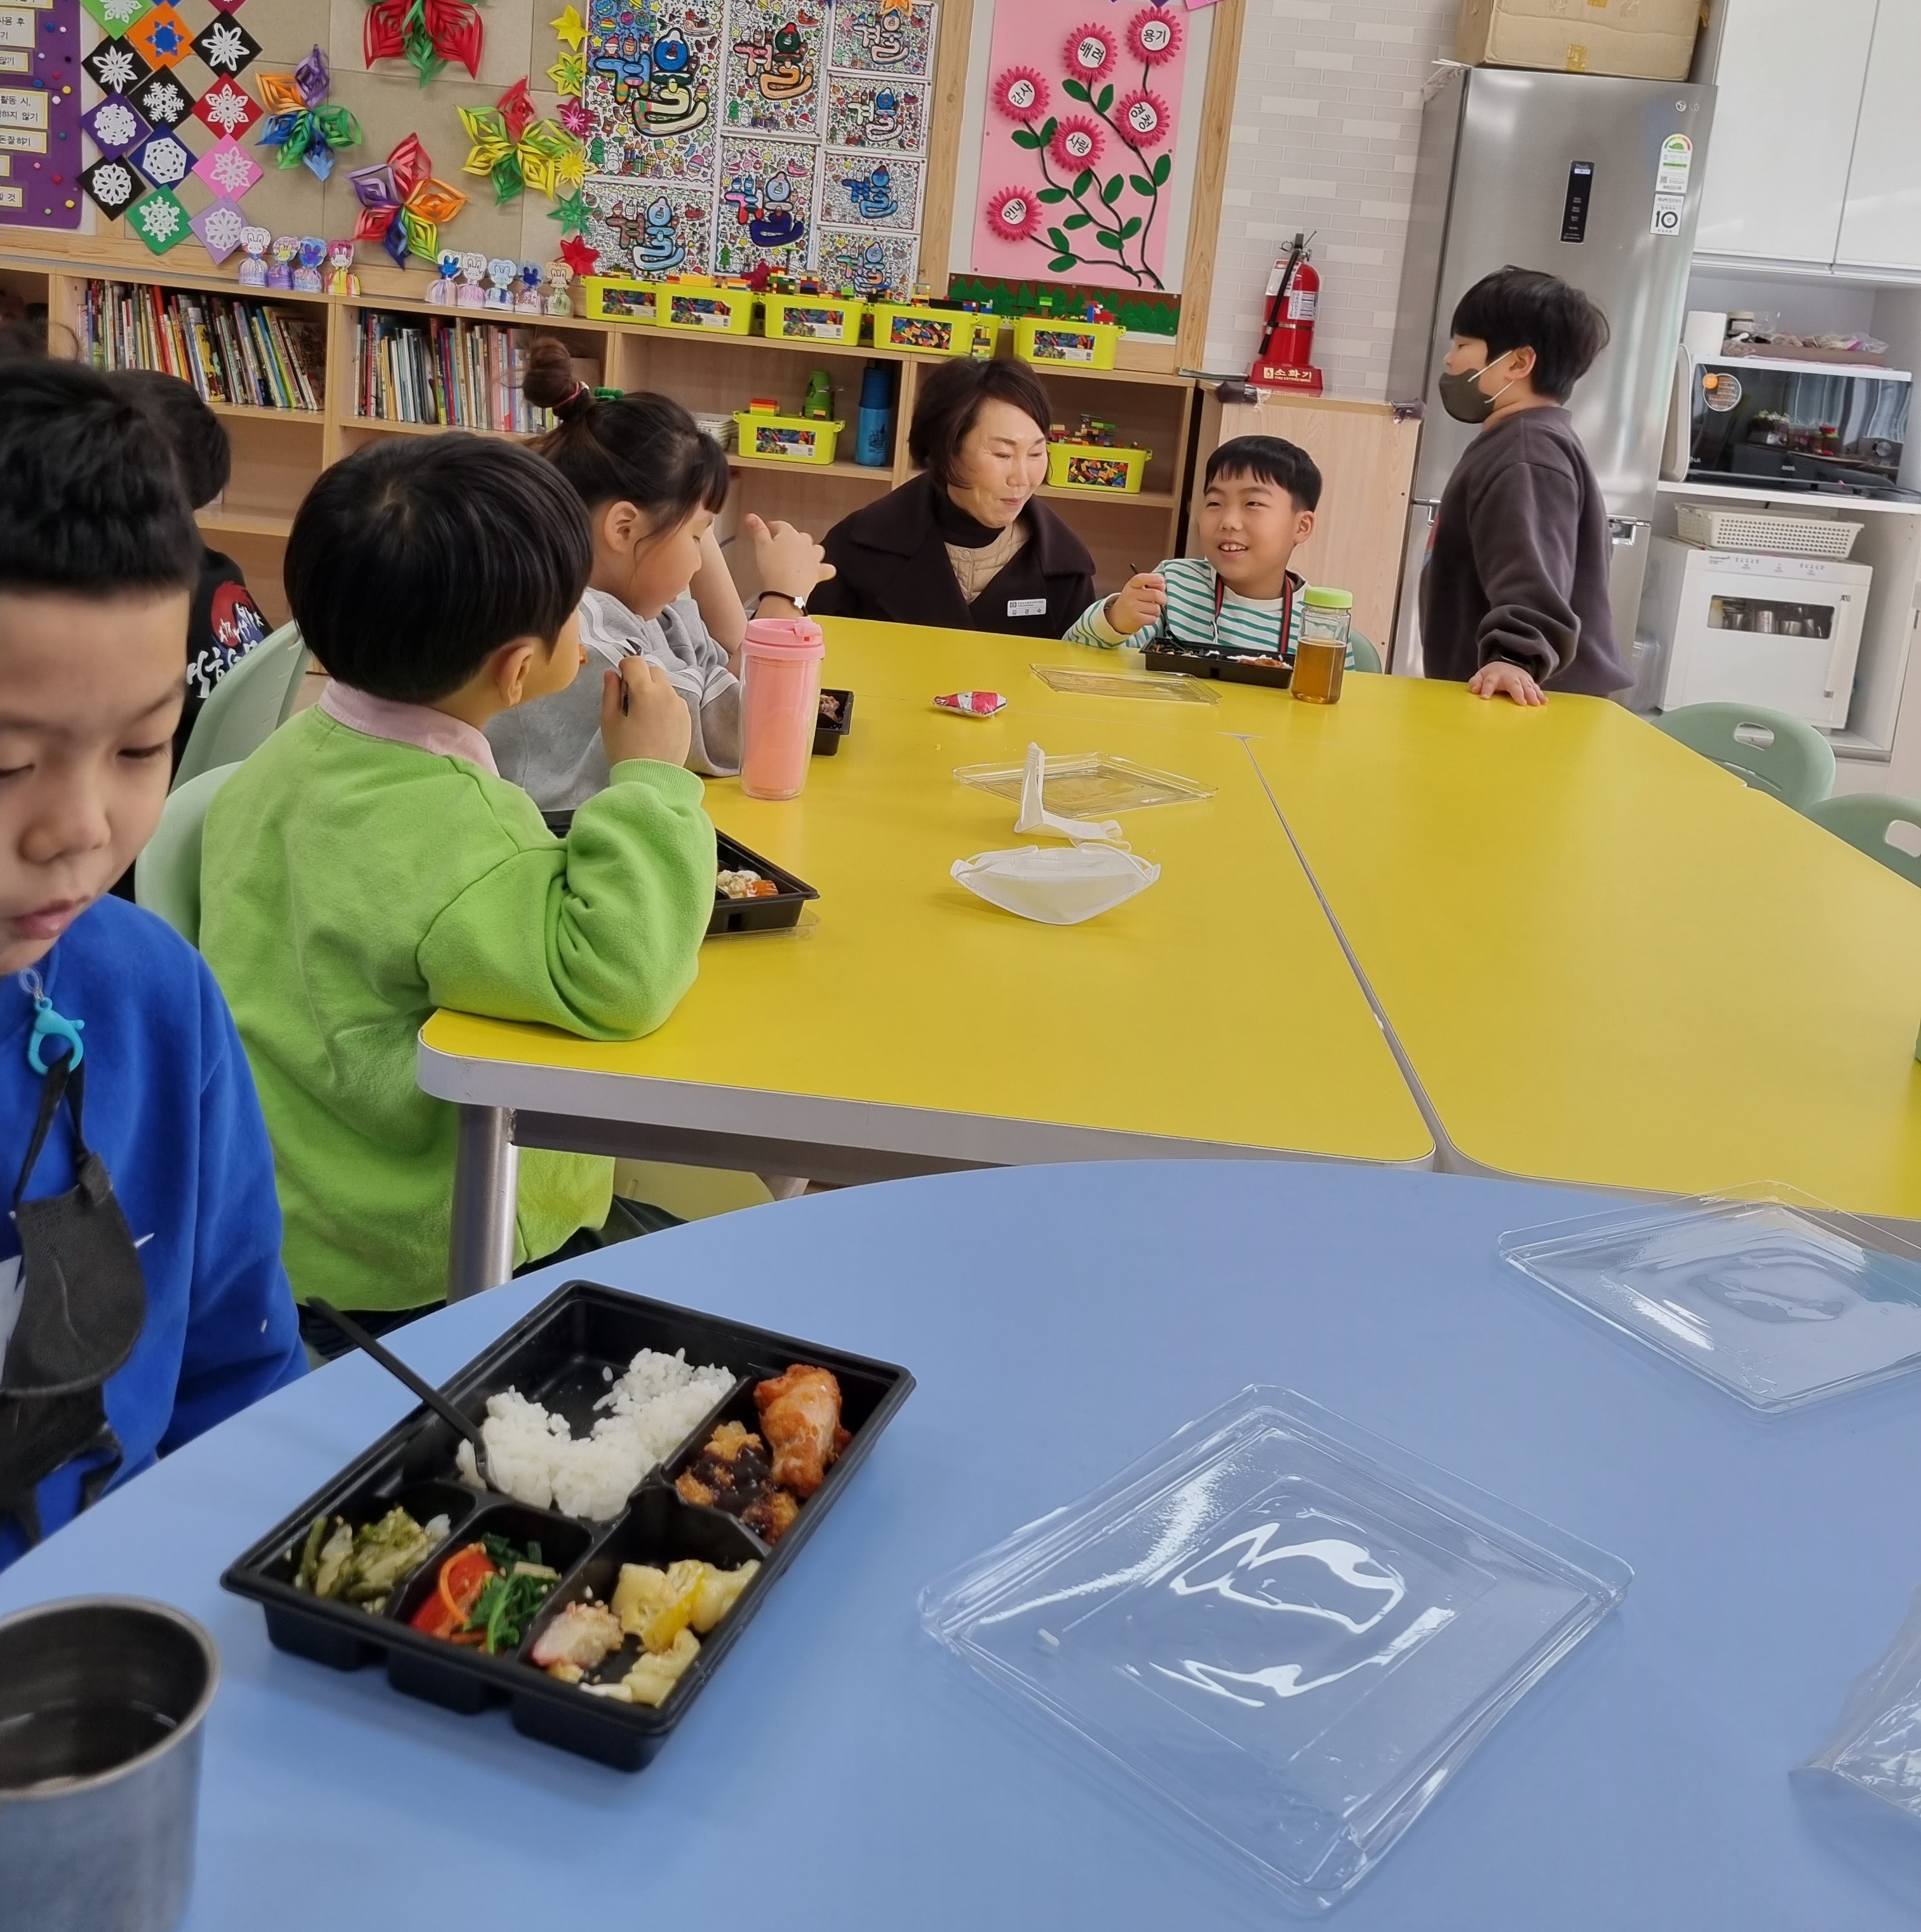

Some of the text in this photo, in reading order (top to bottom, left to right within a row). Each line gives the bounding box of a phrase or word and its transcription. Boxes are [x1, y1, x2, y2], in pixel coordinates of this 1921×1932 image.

[17, 17, 25, 26] 후
[1143, 29, 1167, 43] 용기
[1079, 41, 1105, 65] 배려
[1011, 83, 1033, 105] 감사
[22, 112, 38, 122] 않기
[1131, 102, 1154, 130] 경청
[1068, 135, 1090, 154] 사랑
[8, 194, 15, 203] 것
[1004, 200, 1025, 220] 인내
[1655, 211, 1678, 229] 10
[1274, 368, 1312, 380] 소화기
